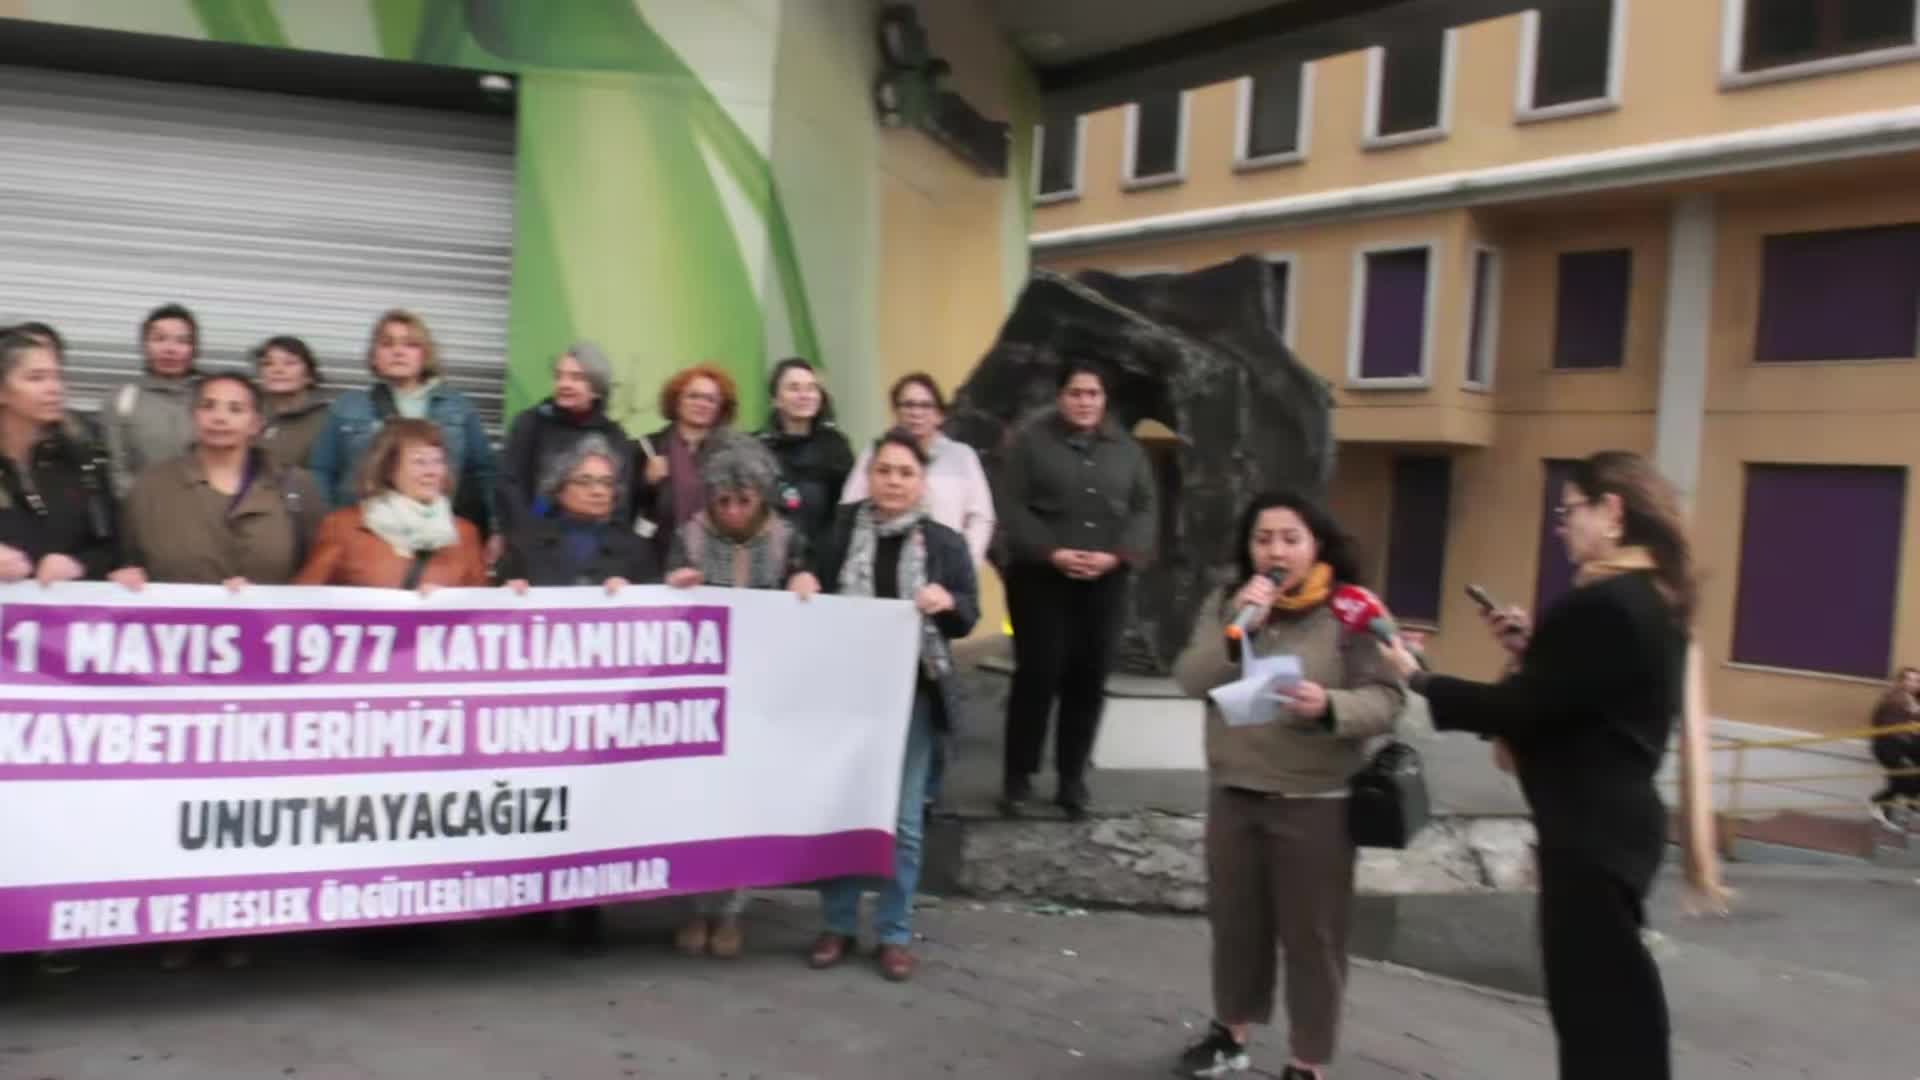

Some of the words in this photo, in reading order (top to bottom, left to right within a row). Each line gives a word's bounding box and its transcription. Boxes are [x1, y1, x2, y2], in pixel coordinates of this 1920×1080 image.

[7, 621, 39, 672] 1
[66, 622, 240, 673] MAYIS
[264, 624, 396, 672] 1977
[415, 615, 722, 672] KATLİAMINDA
[0, 700, 464, 765] KAYBETTİKLERİMİZİ
[477, 699, 720, 754] UNUTMADIK
[179, 781, 569, 850] UNUTMAYACAĞIZ!
[50, 899, 139, 940] EMEK
[149, 895, 188, 933] VE
[197, 888, 311, 930] MESLEK
[319, 871, 543, 922] ÖRGÜTLERİNDEN
[550, 858, 669, 902] KADINLAR
